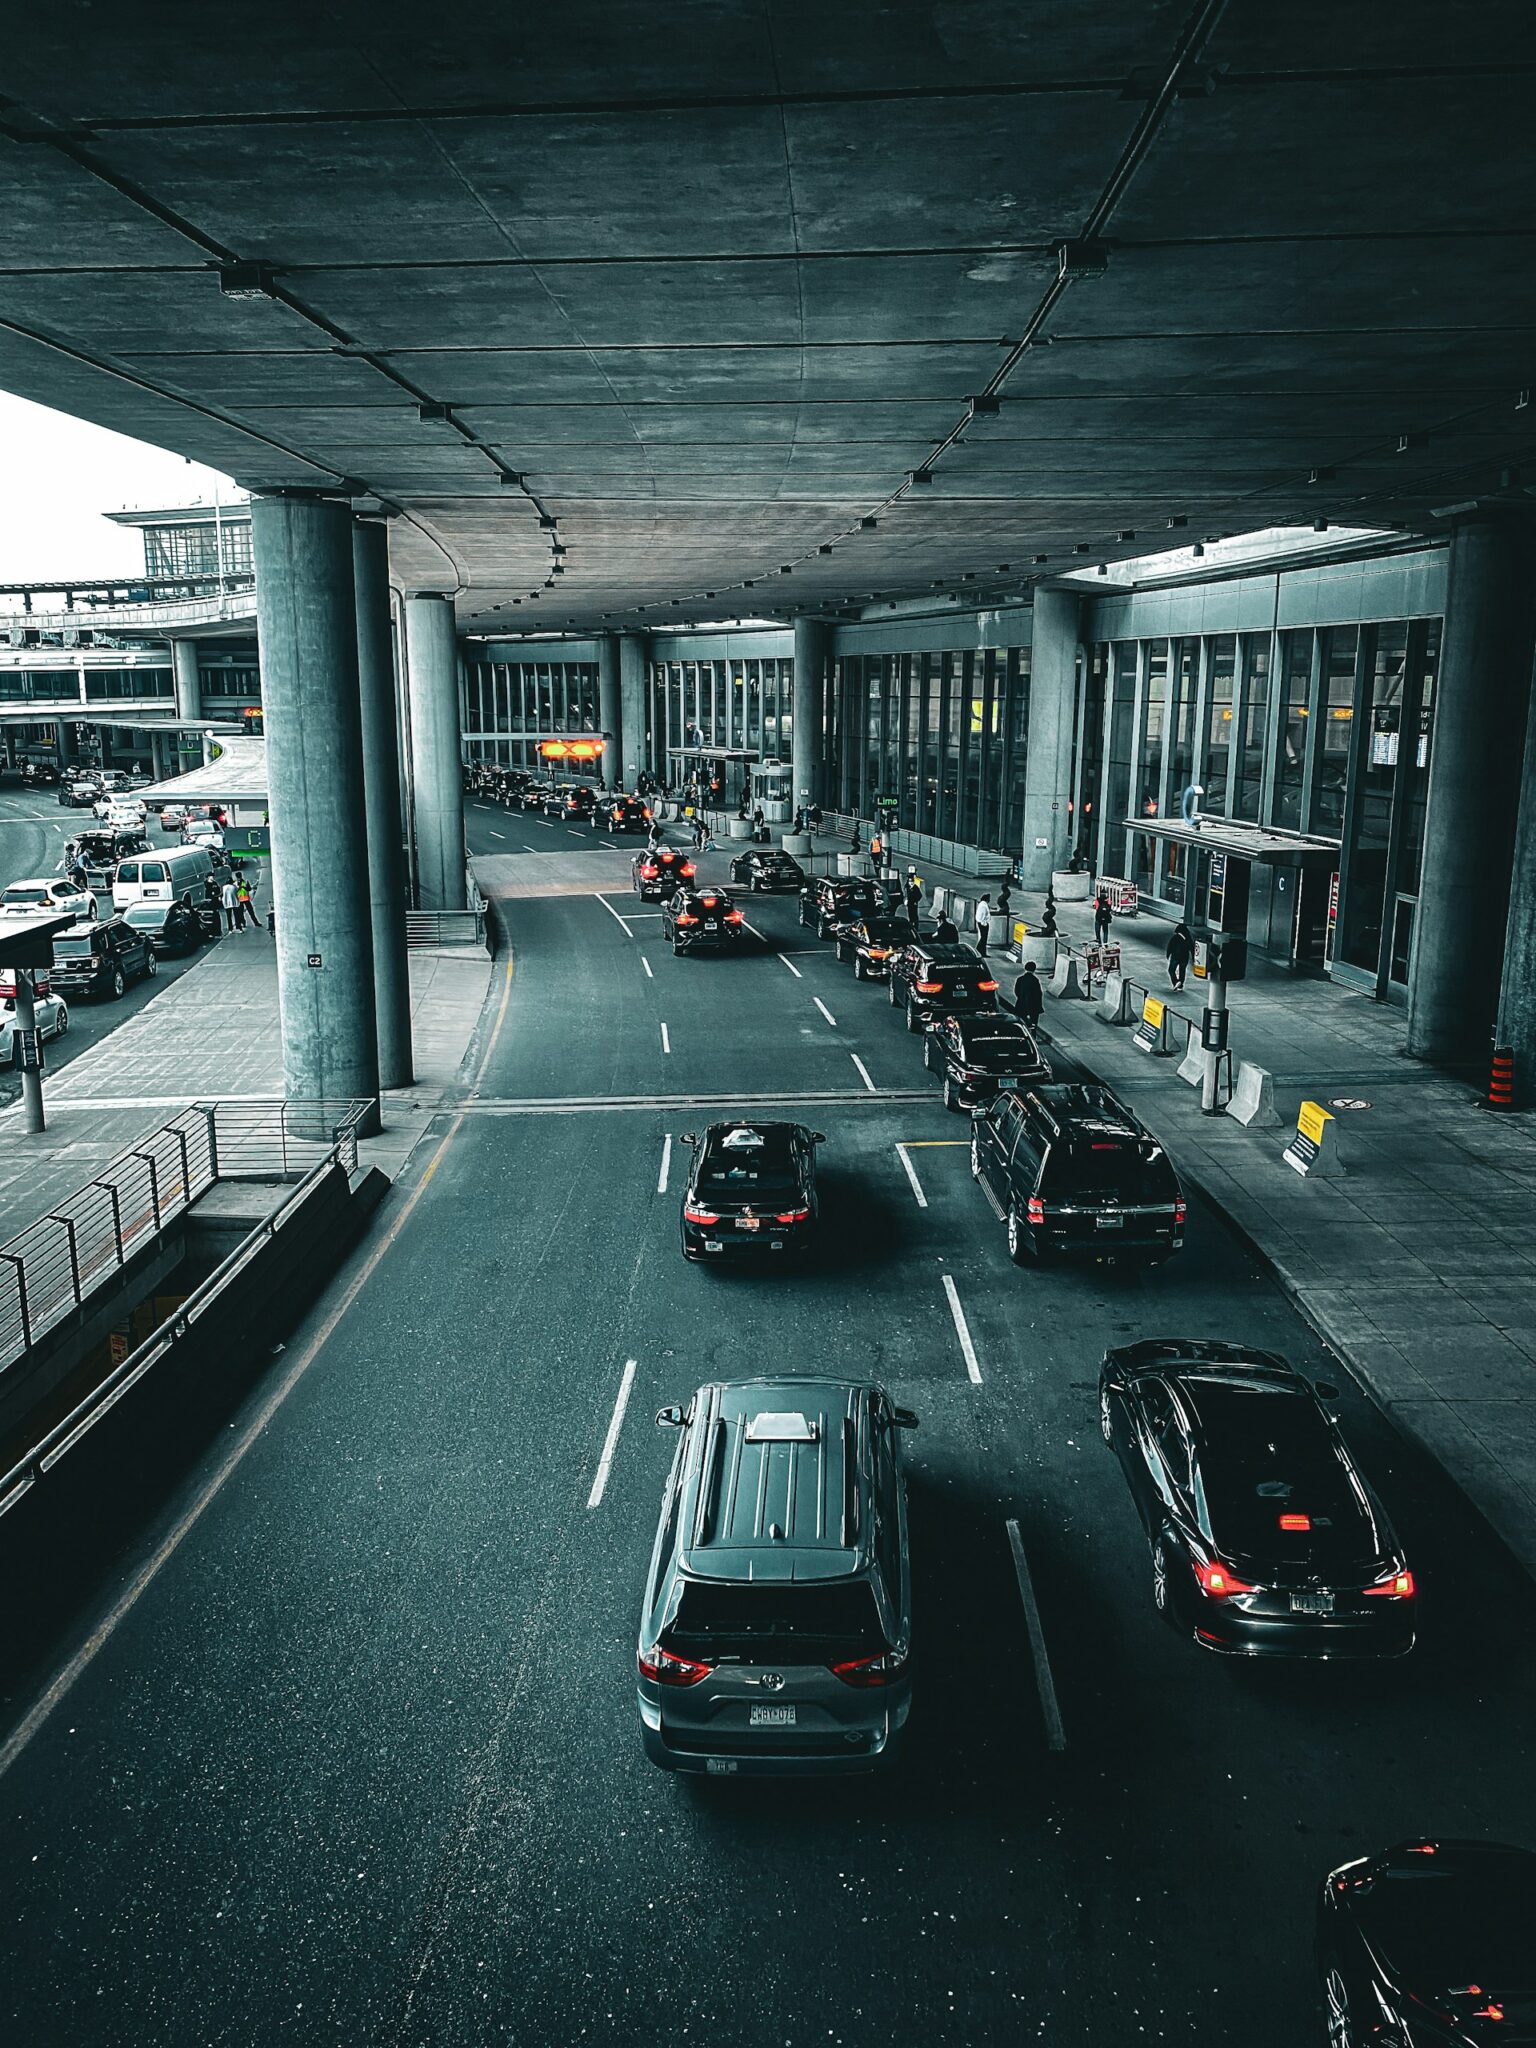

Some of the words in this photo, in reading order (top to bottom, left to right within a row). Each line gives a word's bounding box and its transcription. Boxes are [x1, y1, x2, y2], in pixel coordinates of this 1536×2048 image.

[878, 797, 898, 805] Limo
[1279, 877, 1285, 891] C
[309, 957, 320, 965] C2
